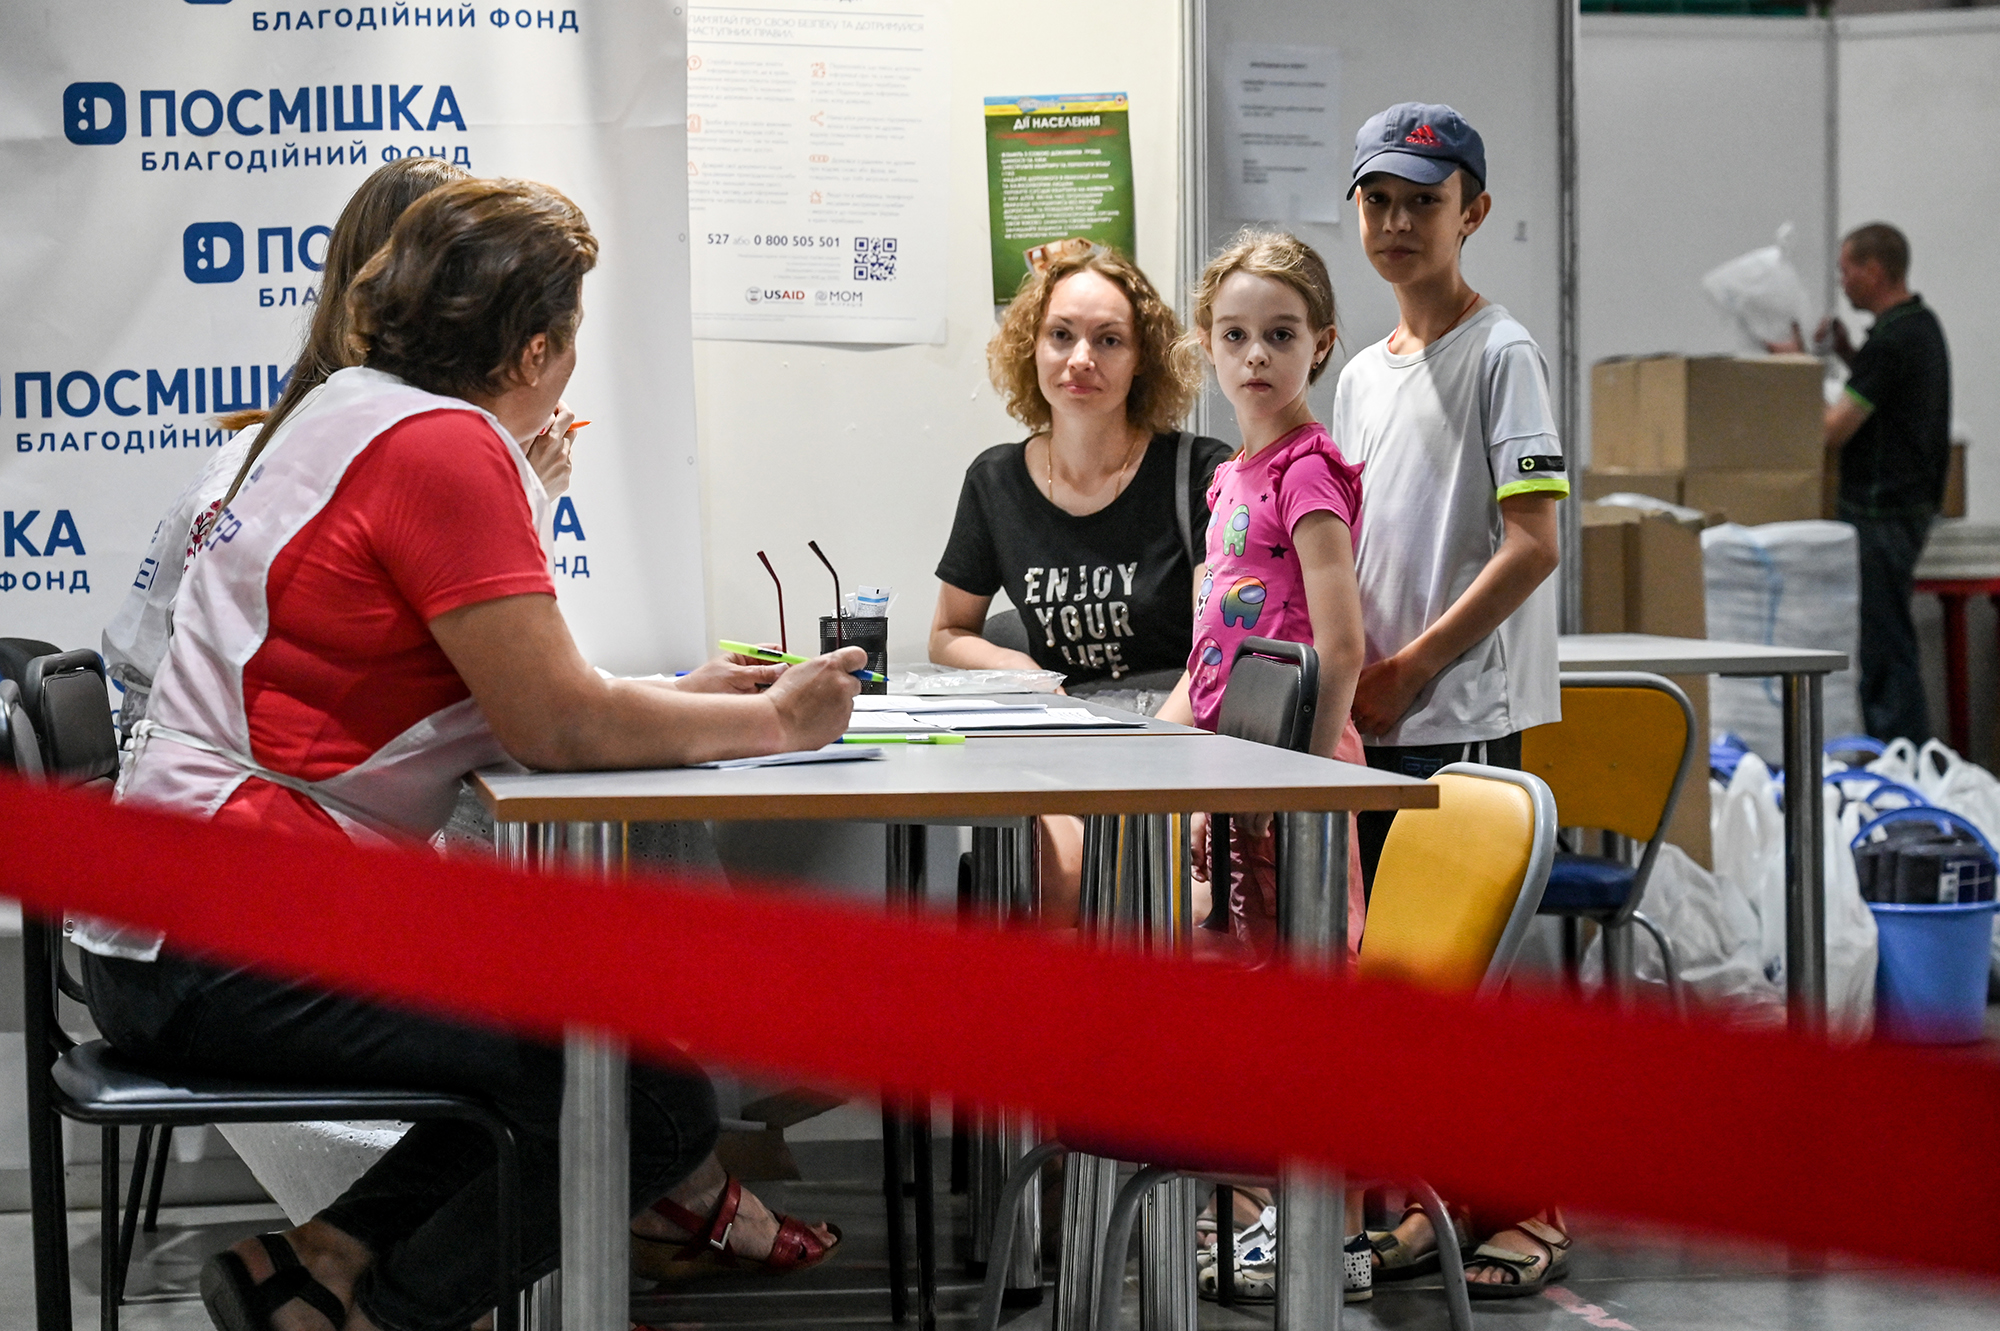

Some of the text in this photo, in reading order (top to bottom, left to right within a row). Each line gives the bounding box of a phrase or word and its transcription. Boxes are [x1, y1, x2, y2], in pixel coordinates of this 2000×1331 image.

[252, 3, 580, 35] БЛАГОДІЙНИЙ ФОНД
[141, 84, 468, 138] ПОСМІШКА
[1032, 115, 1101, 129] НАСЕЛЕННЯ
[141, 141, 472, 174] БЛАГОДІЙНИЙ ФОНД
[708, 233, 730, 245] 527
[753, 234, 763, 247] 0
[765, 234, 789, 247] 800
[791, 235, 815, 248] 505
[818, 236, 841, 248] 501
[763, 289, 806, 301] USAID
[16, 365, 294, 420] ПОСМІШК
[17, 424, 239, 456] БЛАГОДІЙНИ
[0, 569, 91, 595] ФОНД
[1024, 562, 1138, 605] ENJOY
[1035, 601, 1134, 648] YOUR
[1061, 642, 1130, 679] LIFE
